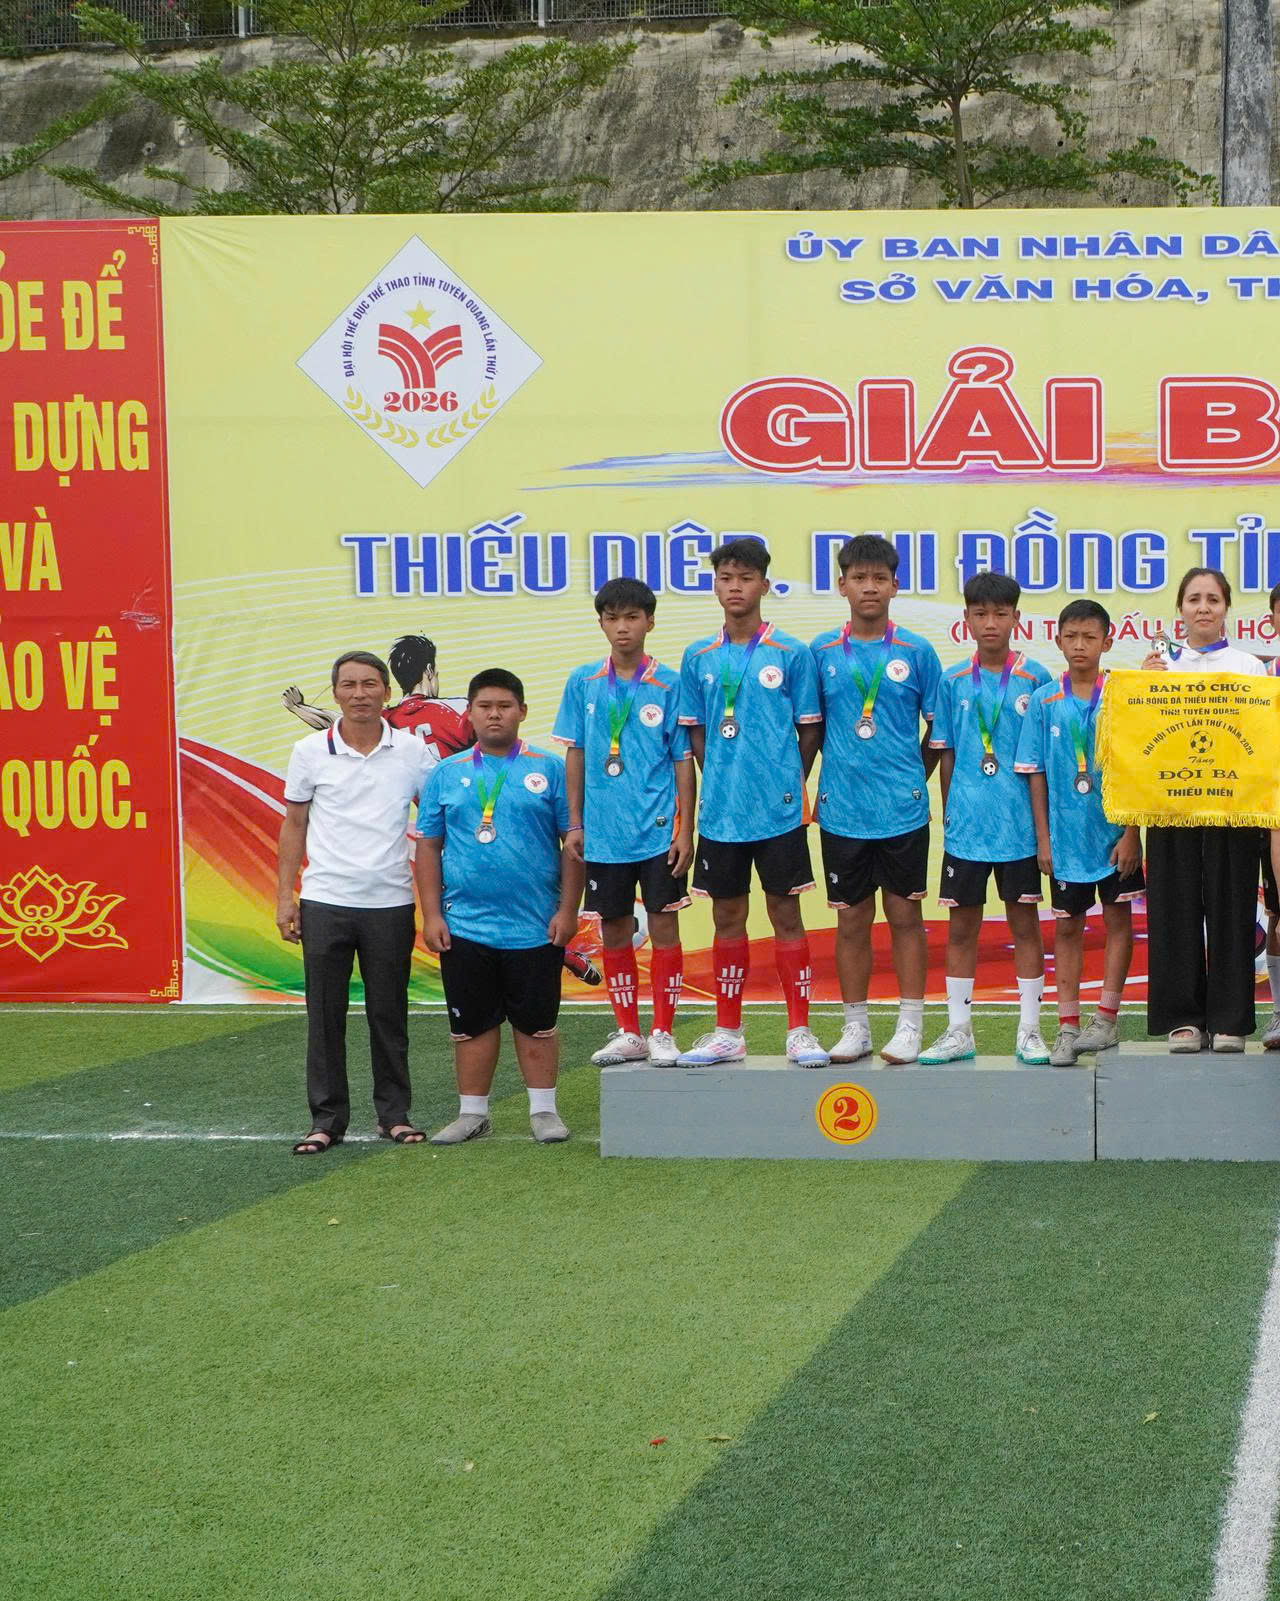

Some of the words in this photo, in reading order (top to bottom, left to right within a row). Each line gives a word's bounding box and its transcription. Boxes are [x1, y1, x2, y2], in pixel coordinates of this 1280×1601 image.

[787, 231, 863, 259] ỦY
[884, 236, 1000, 258] BAN
[1021, 231, 1183, 257] NHÂN
[385, 276, 410, 292] THAO
[413, 272, 436, 288] TỈNH
[439, 279, 468, 302] TUYÊN
[843, 272, 917, 300] SỞ
[936, 274, 1054, 300] VĂN
[1074, 275, 1209, 302] HÓA,
[61, 250, 126, 351] ĐỂ
[367, 282, 385, 303] THỂ
[353, 301, 370, 320] DỤC
[466, 299, 490, 331] QUANG
[345, 317, 359, 338] THỂ
[341, 341, 354, 357] HỘI
[343, 361, 355, 377] ĐẠI
[384, 391, 458, 412] 2026
[720, 346, 1104, 473] GIẢI
[14, 394, 150, 488] DỰNG
[0, 506, 63, 591] VÀ
[343, 514, 568, 593] THIẾU
[958, 511, 1166, 591] ĐỒNG
[59, 625, 119, 726] VỆ
[1149, 684, 1182, 693] BAN
[1186, 680, 1206, 692] TỔ
[1210, 682, 1252, 692] CHỨC
[1209, 695, 1228, 704] NIÊN
[1234, 696, 1247, 705] NHI
[1159, 767, 1204, 782] ĐỘI
[1212, 768, 1239, 780] BA
[1, 734, 147, 838] QUỐC.
[1166, 786, 1203, 797] THIẾU
[1206, 787, 1233, 797] NIÊN
[833, 1096, 861, 1132] 2
